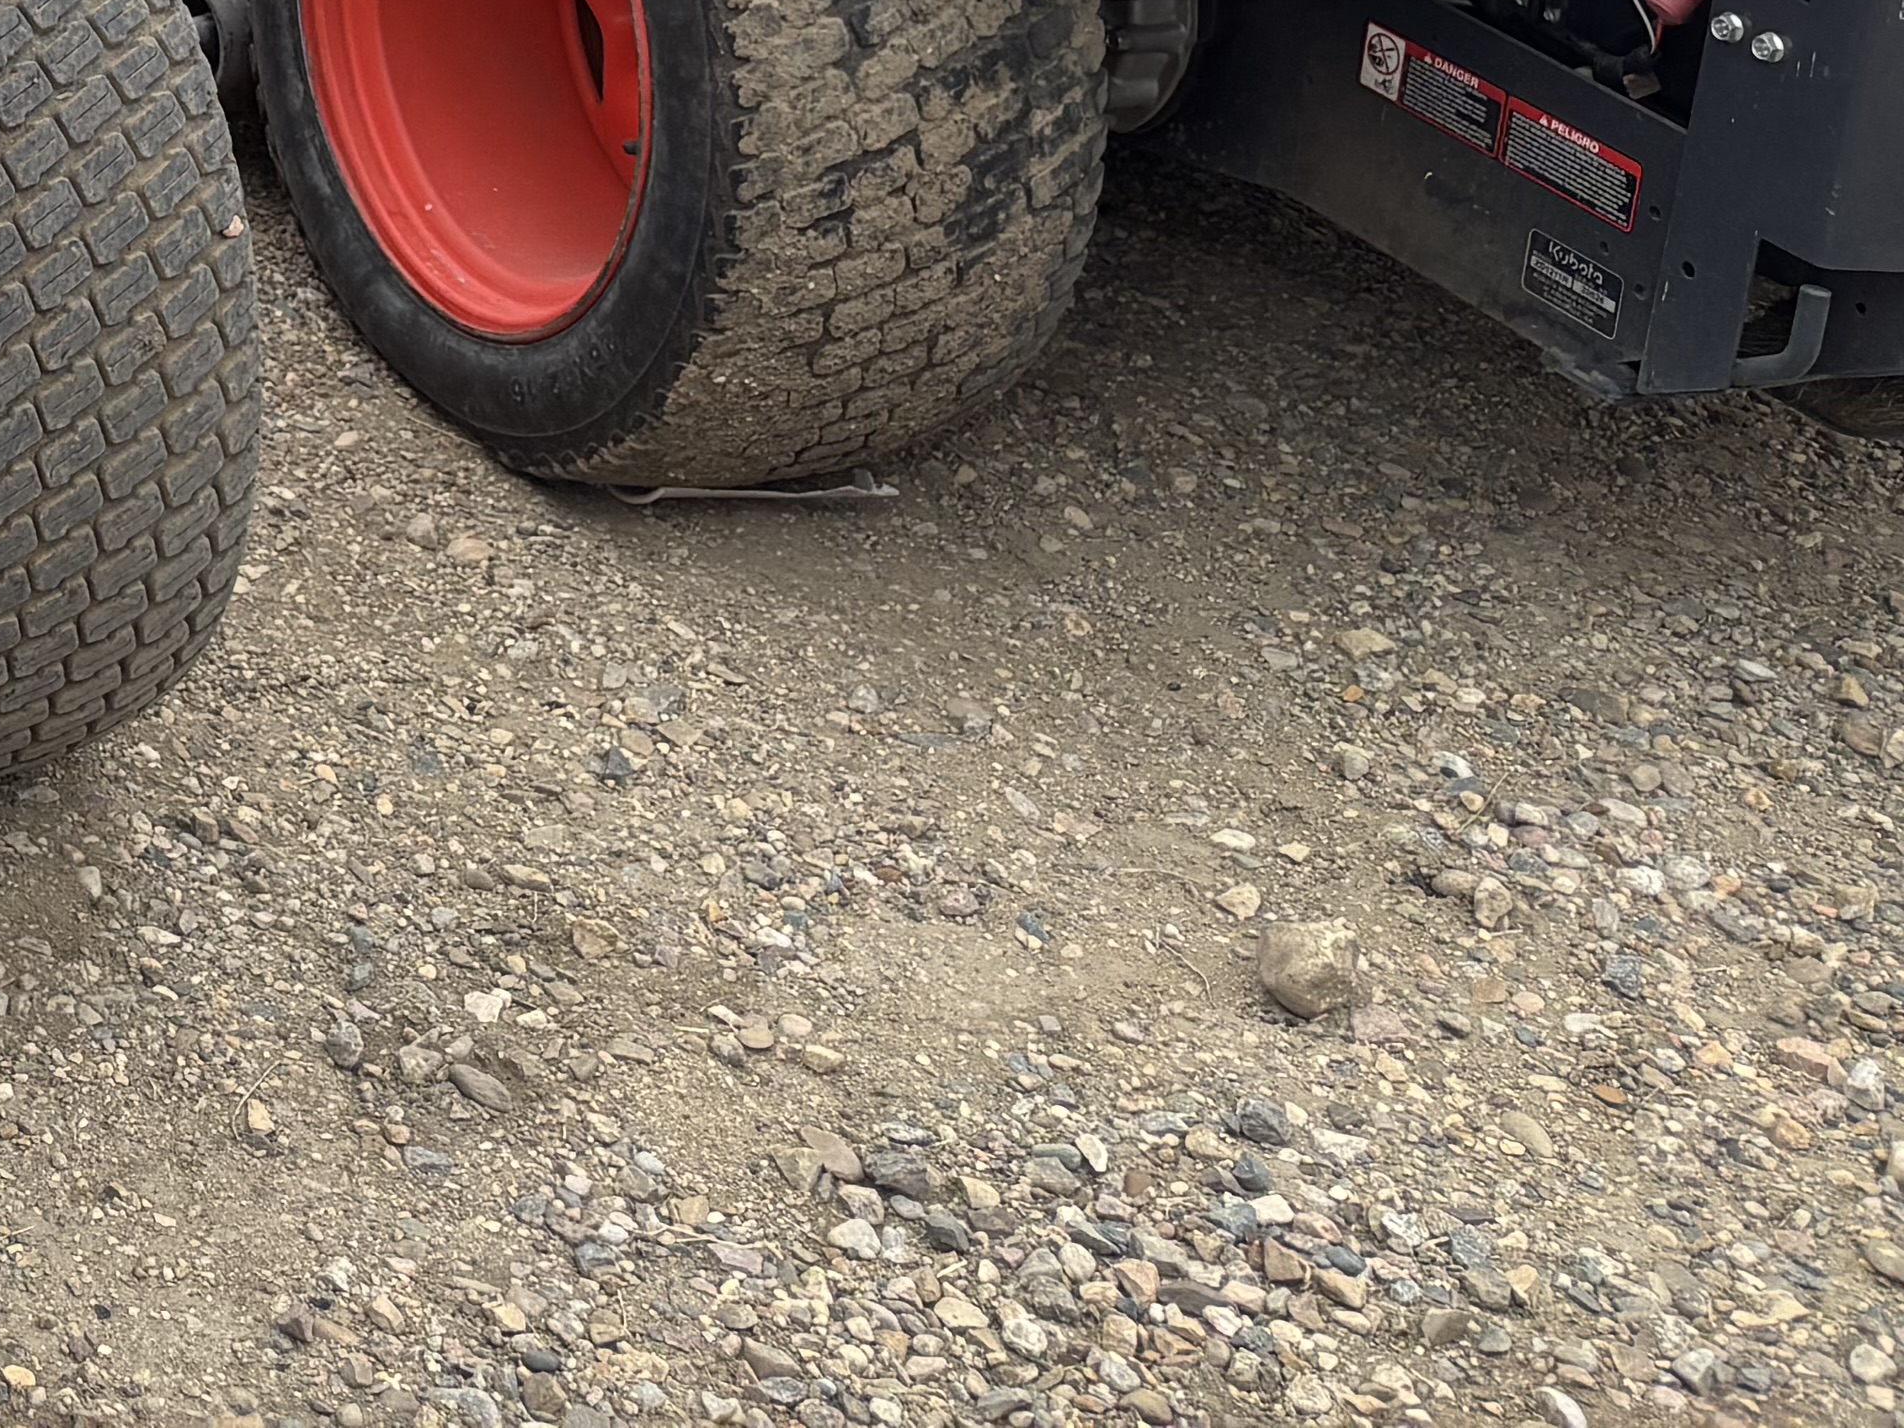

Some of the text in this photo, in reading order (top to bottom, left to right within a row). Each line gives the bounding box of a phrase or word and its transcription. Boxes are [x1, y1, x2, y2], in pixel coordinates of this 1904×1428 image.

[1433, 57, 1480, 89] DANGER
[1550, 119, 1600, 154] PELIGRO
[1548, 240, 1604, 285] Kubota
